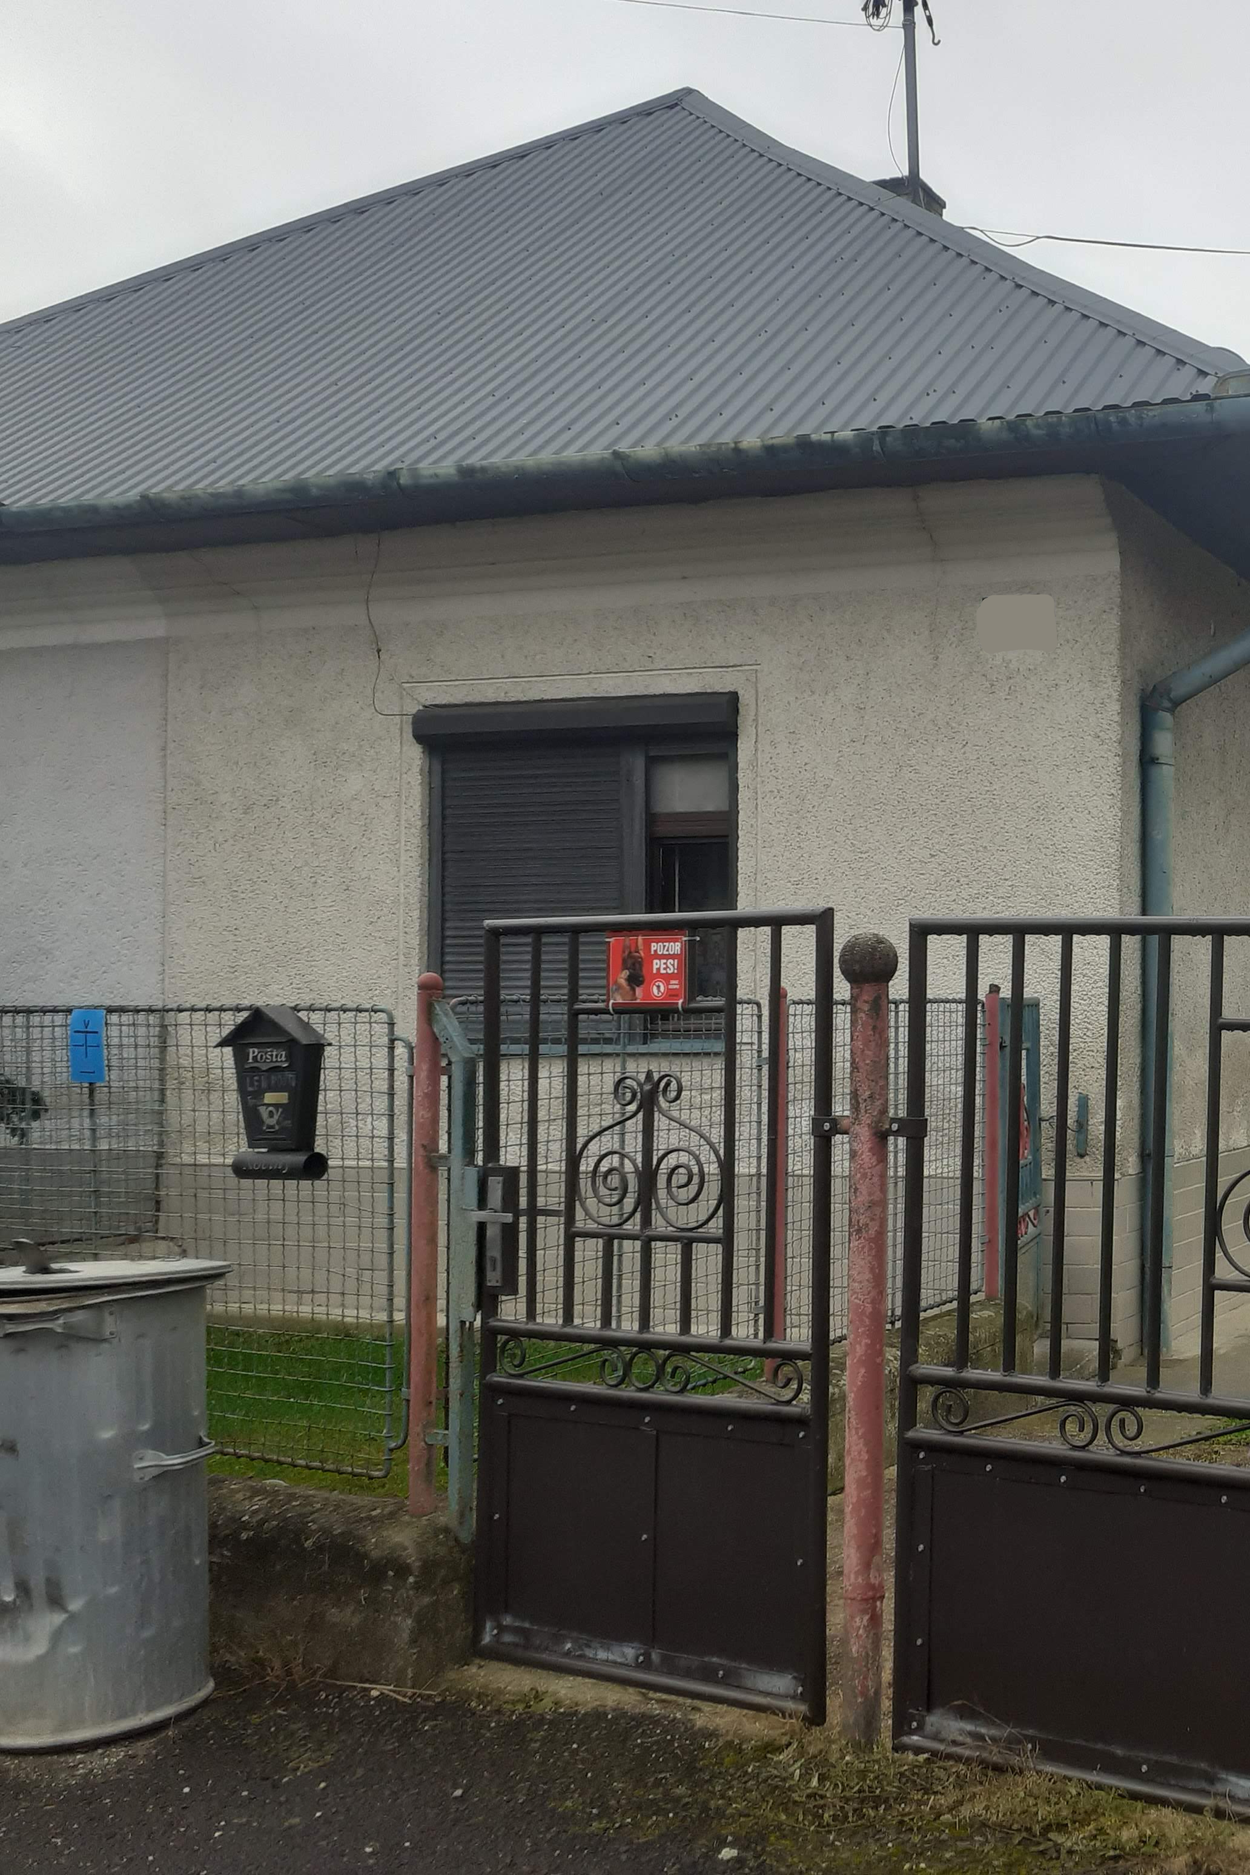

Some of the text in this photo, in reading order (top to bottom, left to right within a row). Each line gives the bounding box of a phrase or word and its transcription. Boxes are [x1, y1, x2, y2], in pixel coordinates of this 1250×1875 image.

[651, 942, 681, 955] POZOR
[652, 959, 678, 974] PES!
[247, 1048, 287, 1063] Pošta
